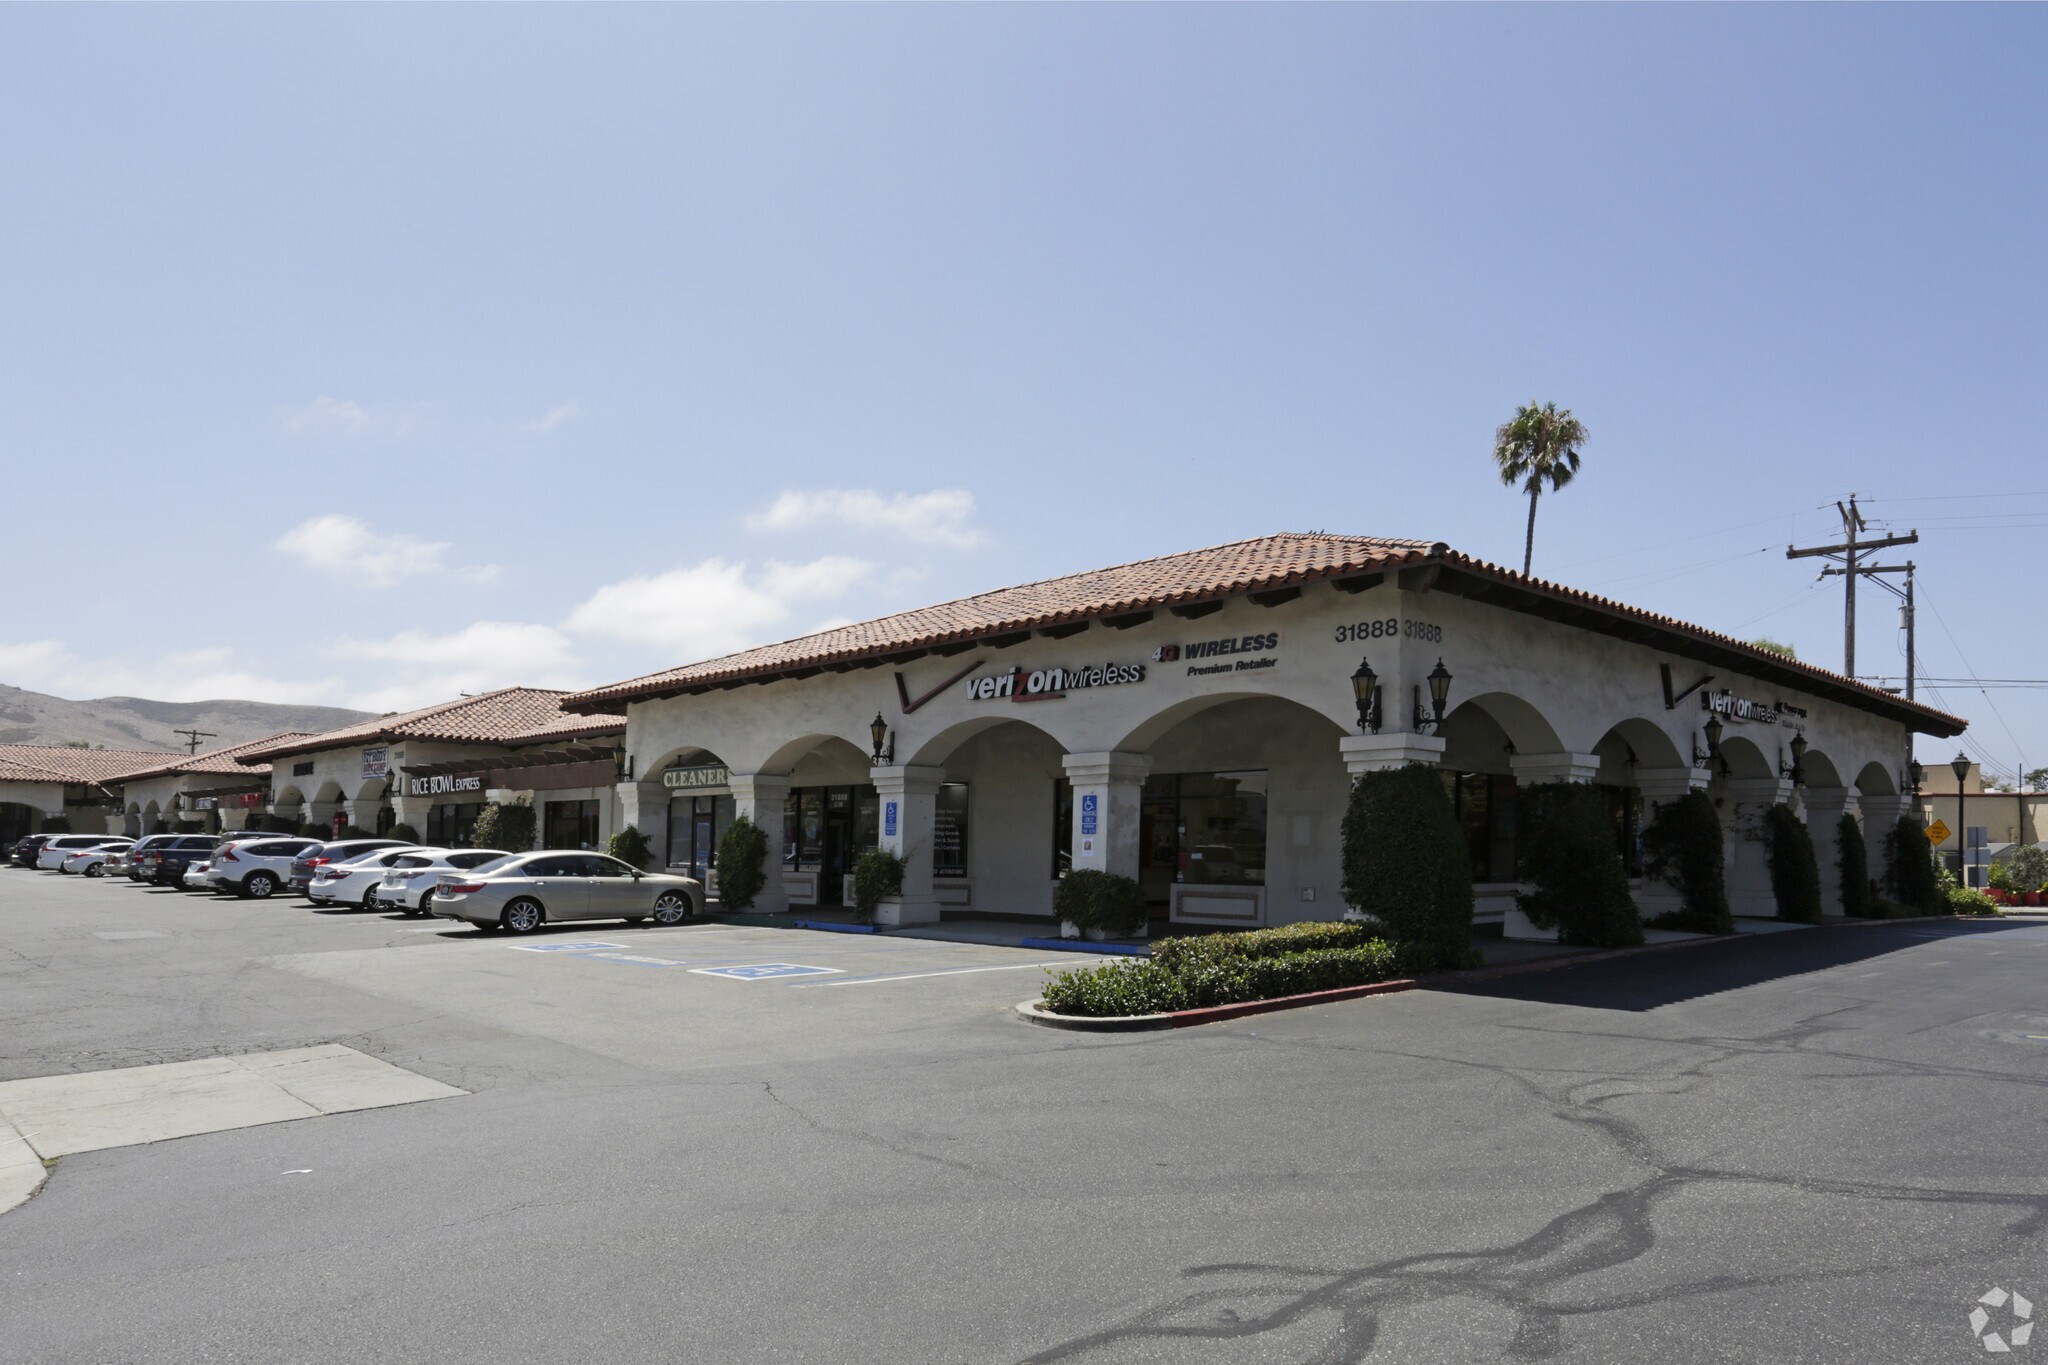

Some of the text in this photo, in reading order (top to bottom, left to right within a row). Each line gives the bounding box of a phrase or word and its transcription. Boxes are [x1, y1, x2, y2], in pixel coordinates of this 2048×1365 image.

[1335, 618, 1398, 643] 31888
[1404, 619, 1442, 643] 31888
[1151, 632, 1279, 663] 4G WIRELESS
[1187, 657, 1278, 677] Premium Retailer
[966, 661, 1146, 703] verizon wireless
[1708, 689, 1753, 725] verizon
[411, 775, 480, 795] RICE BOWL EXPRESS
